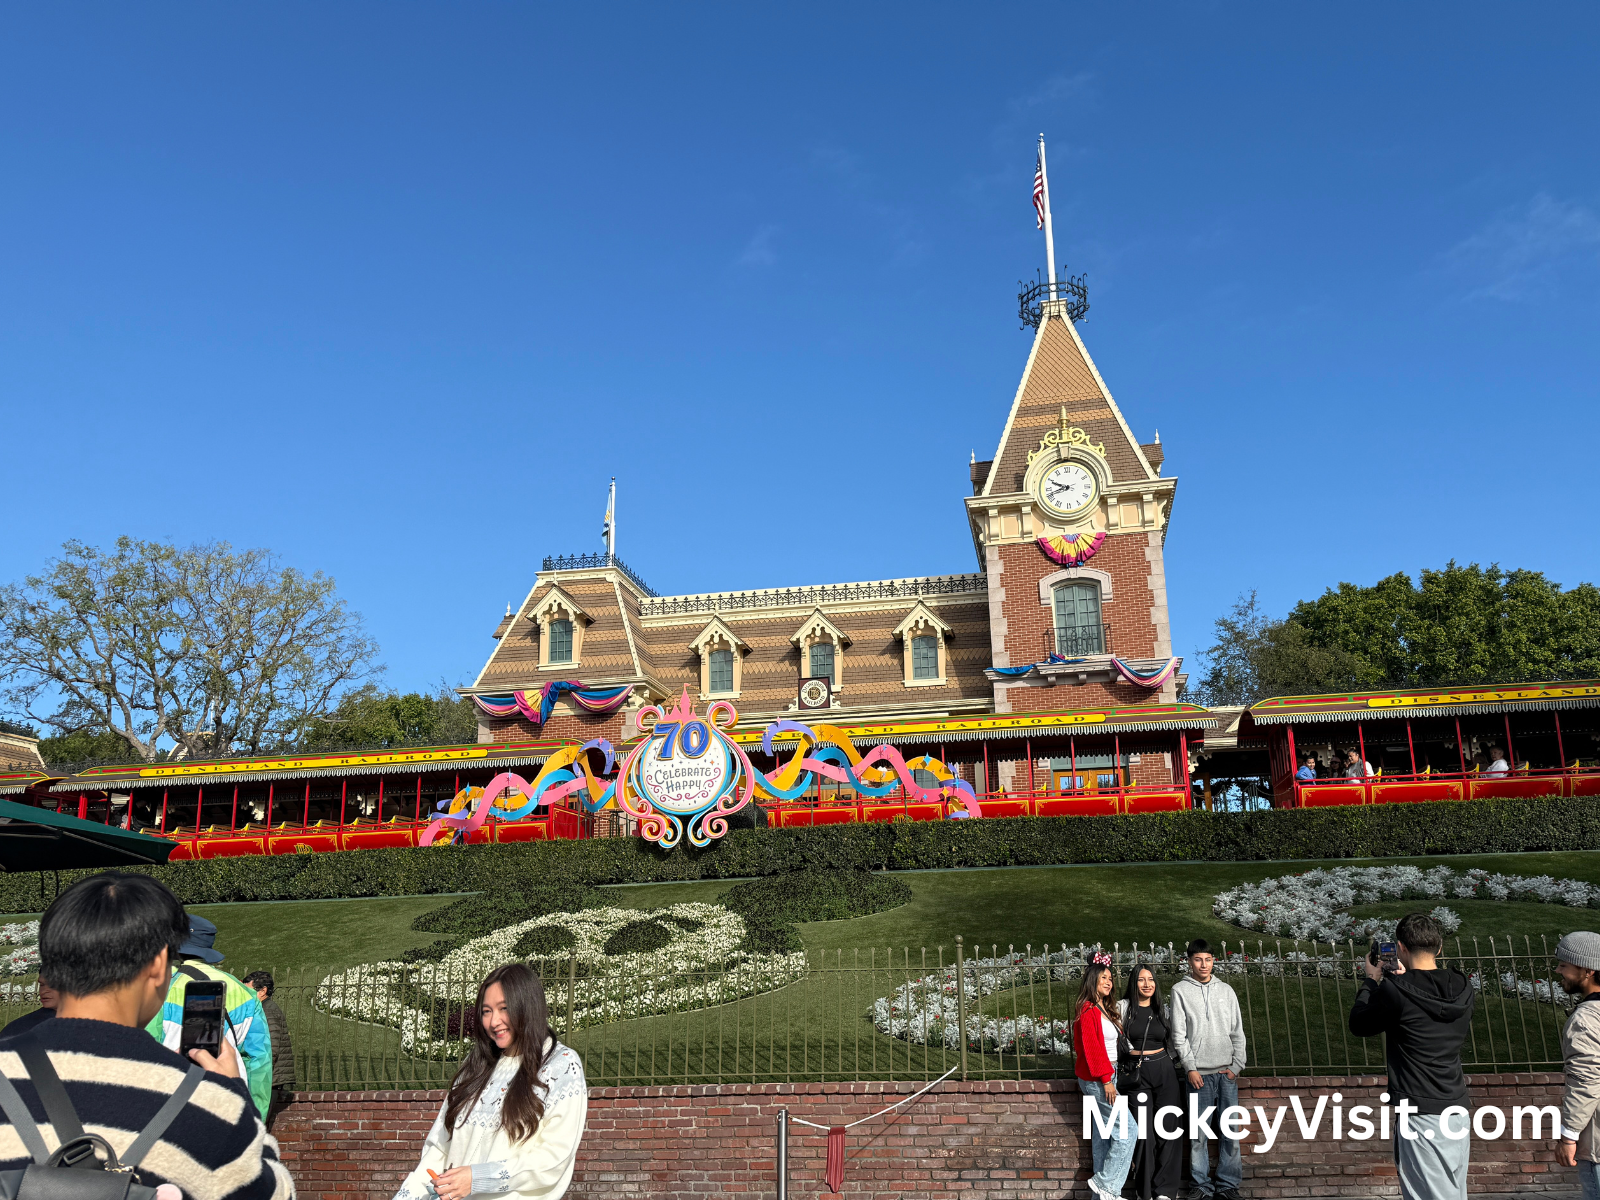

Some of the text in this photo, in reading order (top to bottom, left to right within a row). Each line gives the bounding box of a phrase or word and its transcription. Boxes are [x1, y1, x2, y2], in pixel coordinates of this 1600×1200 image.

[1390, 688, 1598, 704] DISNEYLAND
[936, 716, 1085, 729] RAILROAD
[653, 718, 713, 761] 70
[155, 751, 470, 775] DISNEYLAND RAILROAD
[654, 767, 712, 785] CELEBRATE
[665, 779, 702, 794] HAPPY
